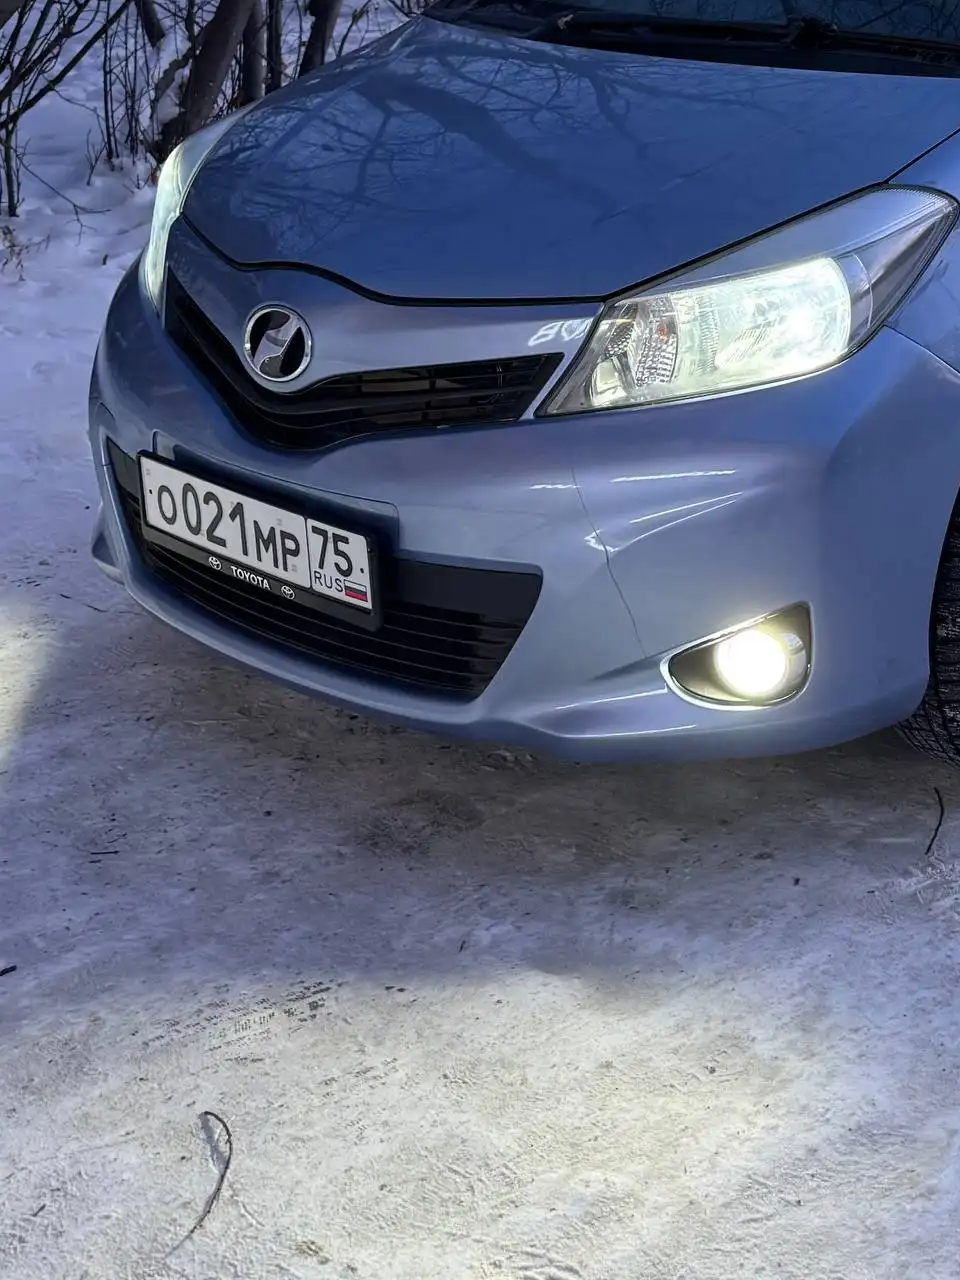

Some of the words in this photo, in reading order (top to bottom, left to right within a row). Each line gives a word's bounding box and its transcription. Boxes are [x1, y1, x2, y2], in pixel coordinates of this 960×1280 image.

[311, 525, 353, 577] 75
[230, 566, 271, 591] TOYOTA
[314, 573, 344, 593] RUS
